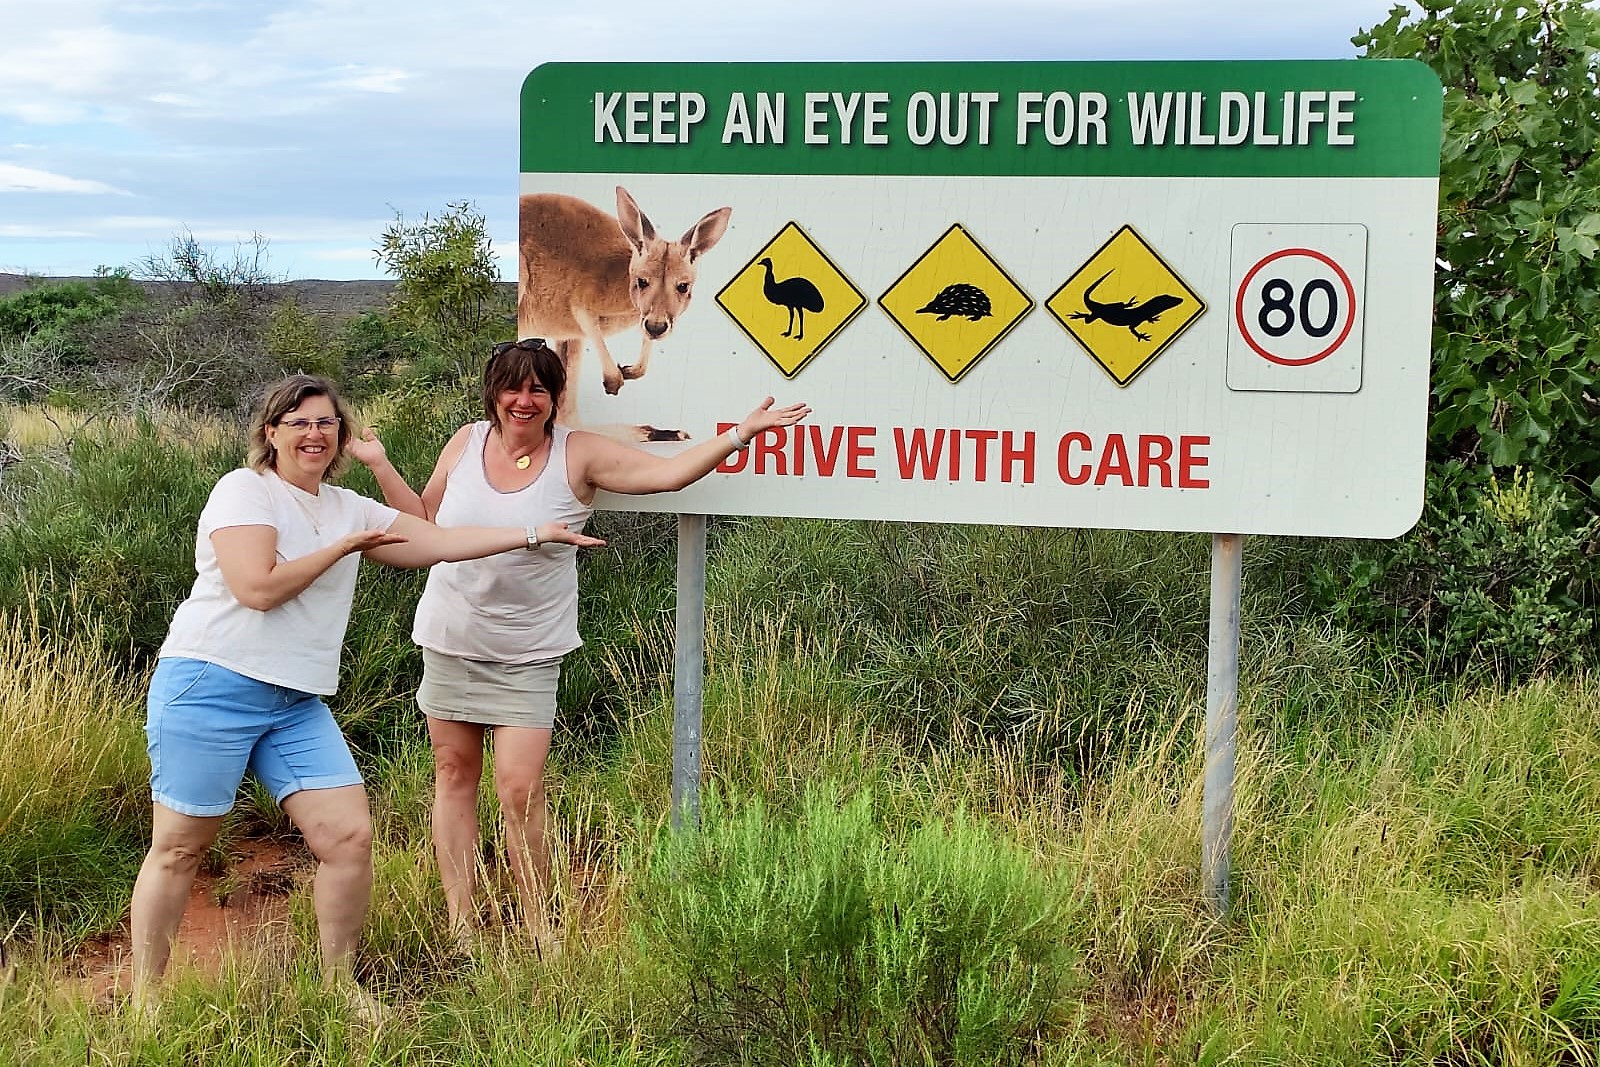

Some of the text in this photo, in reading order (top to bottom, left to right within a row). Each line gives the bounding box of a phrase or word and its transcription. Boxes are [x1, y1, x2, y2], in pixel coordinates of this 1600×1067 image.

[595, 91, 1355, 145] KEEP AN EYE OUT FOR WILDLIFE
[1259, 279, 1337, 337] 80
[894, 429, 1034, 482] WITH
[1058, 432, 1208, 487] CARE
